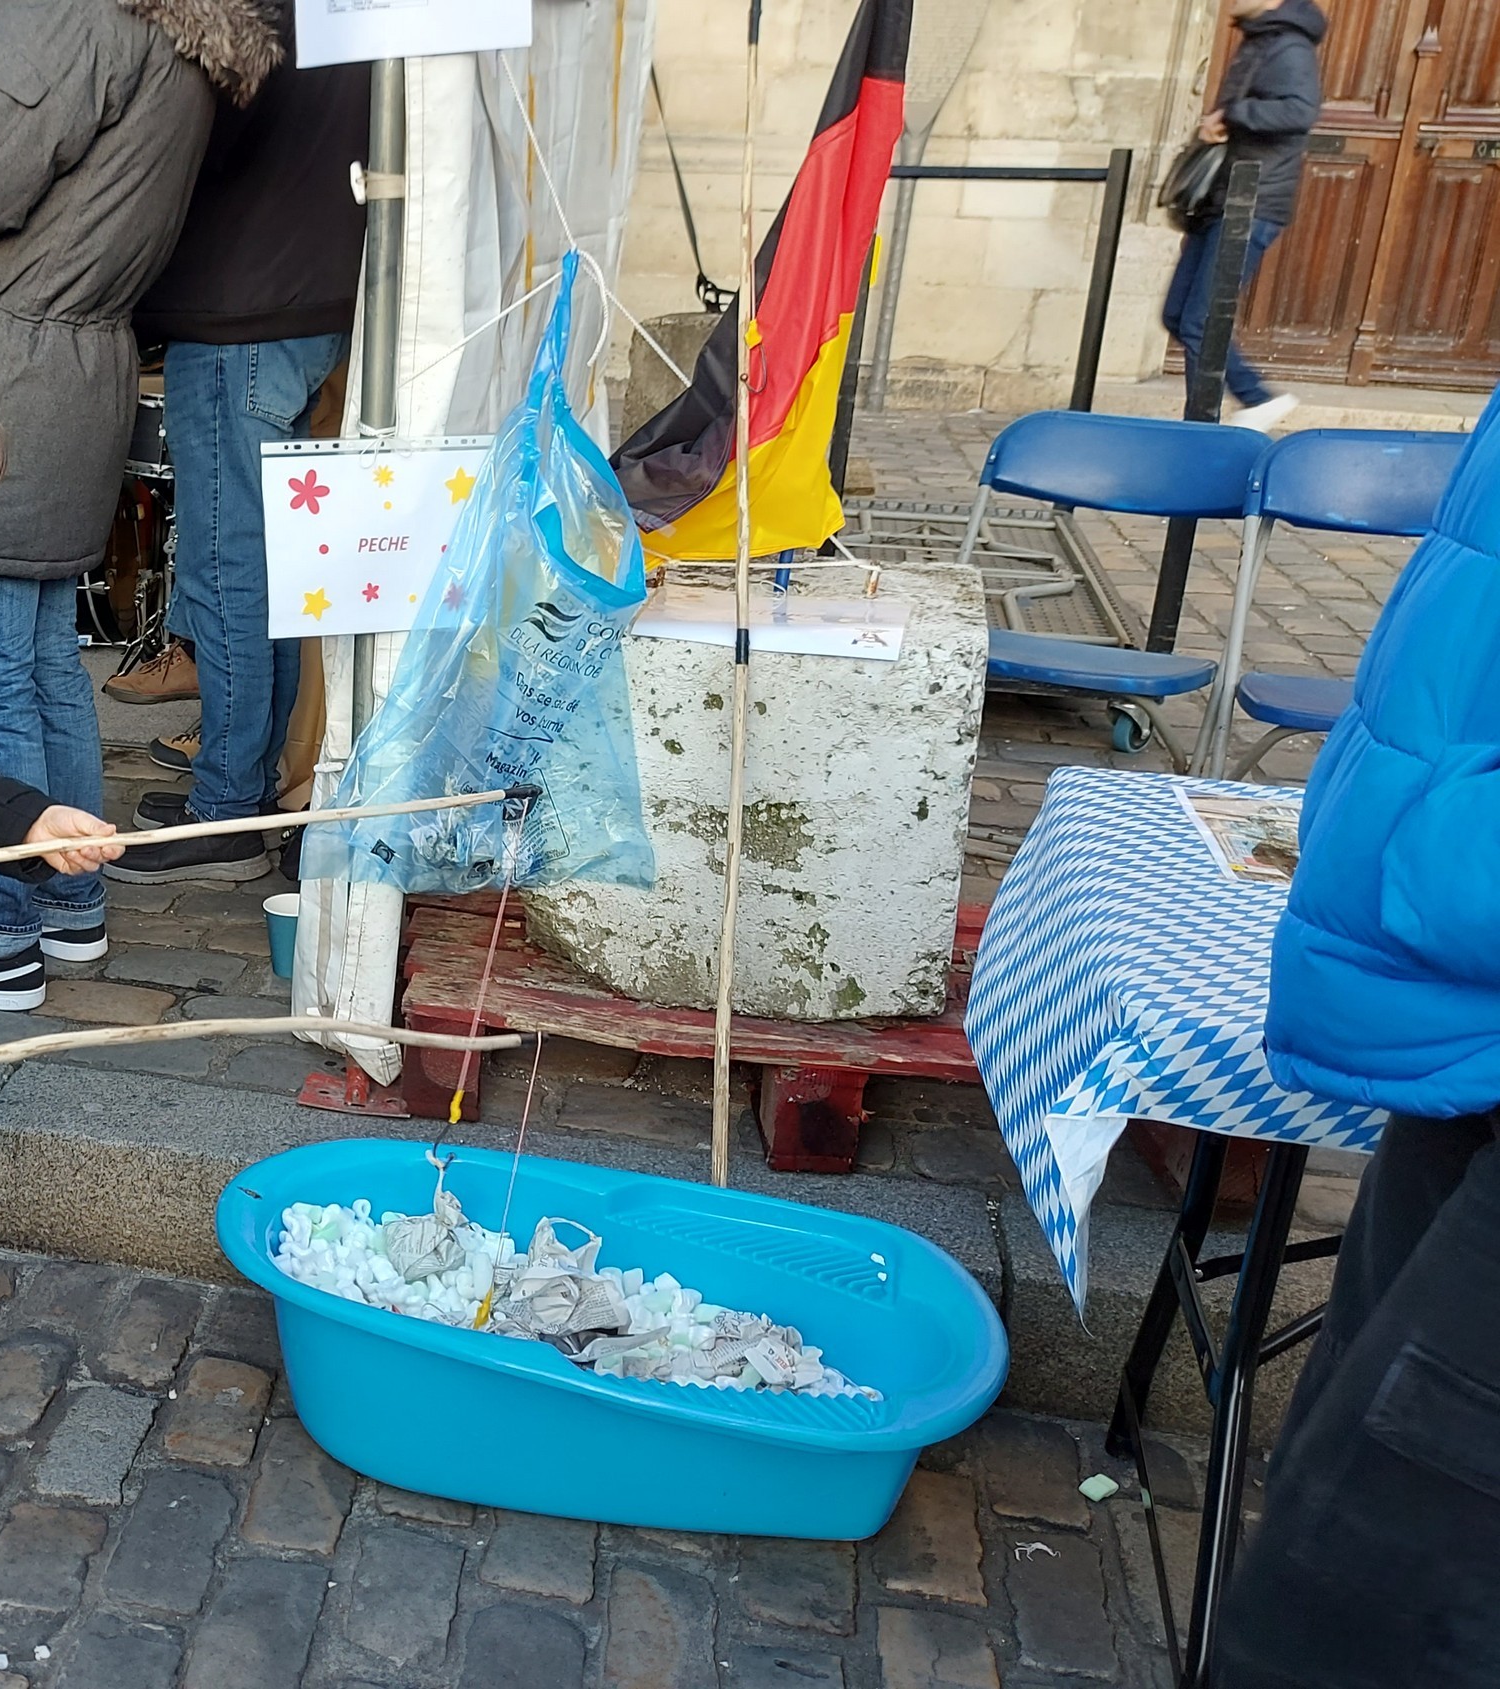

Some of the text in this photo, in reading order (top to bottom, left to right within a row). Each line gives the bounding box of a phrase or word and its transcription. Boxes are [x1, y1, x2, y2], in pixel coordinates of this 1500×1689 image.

[358, 536, 410, 553] PECHE
[522, 637, 541, 655] LA
[536, 693, 552, 706] ce
[515, 707, 537, 726] vos
